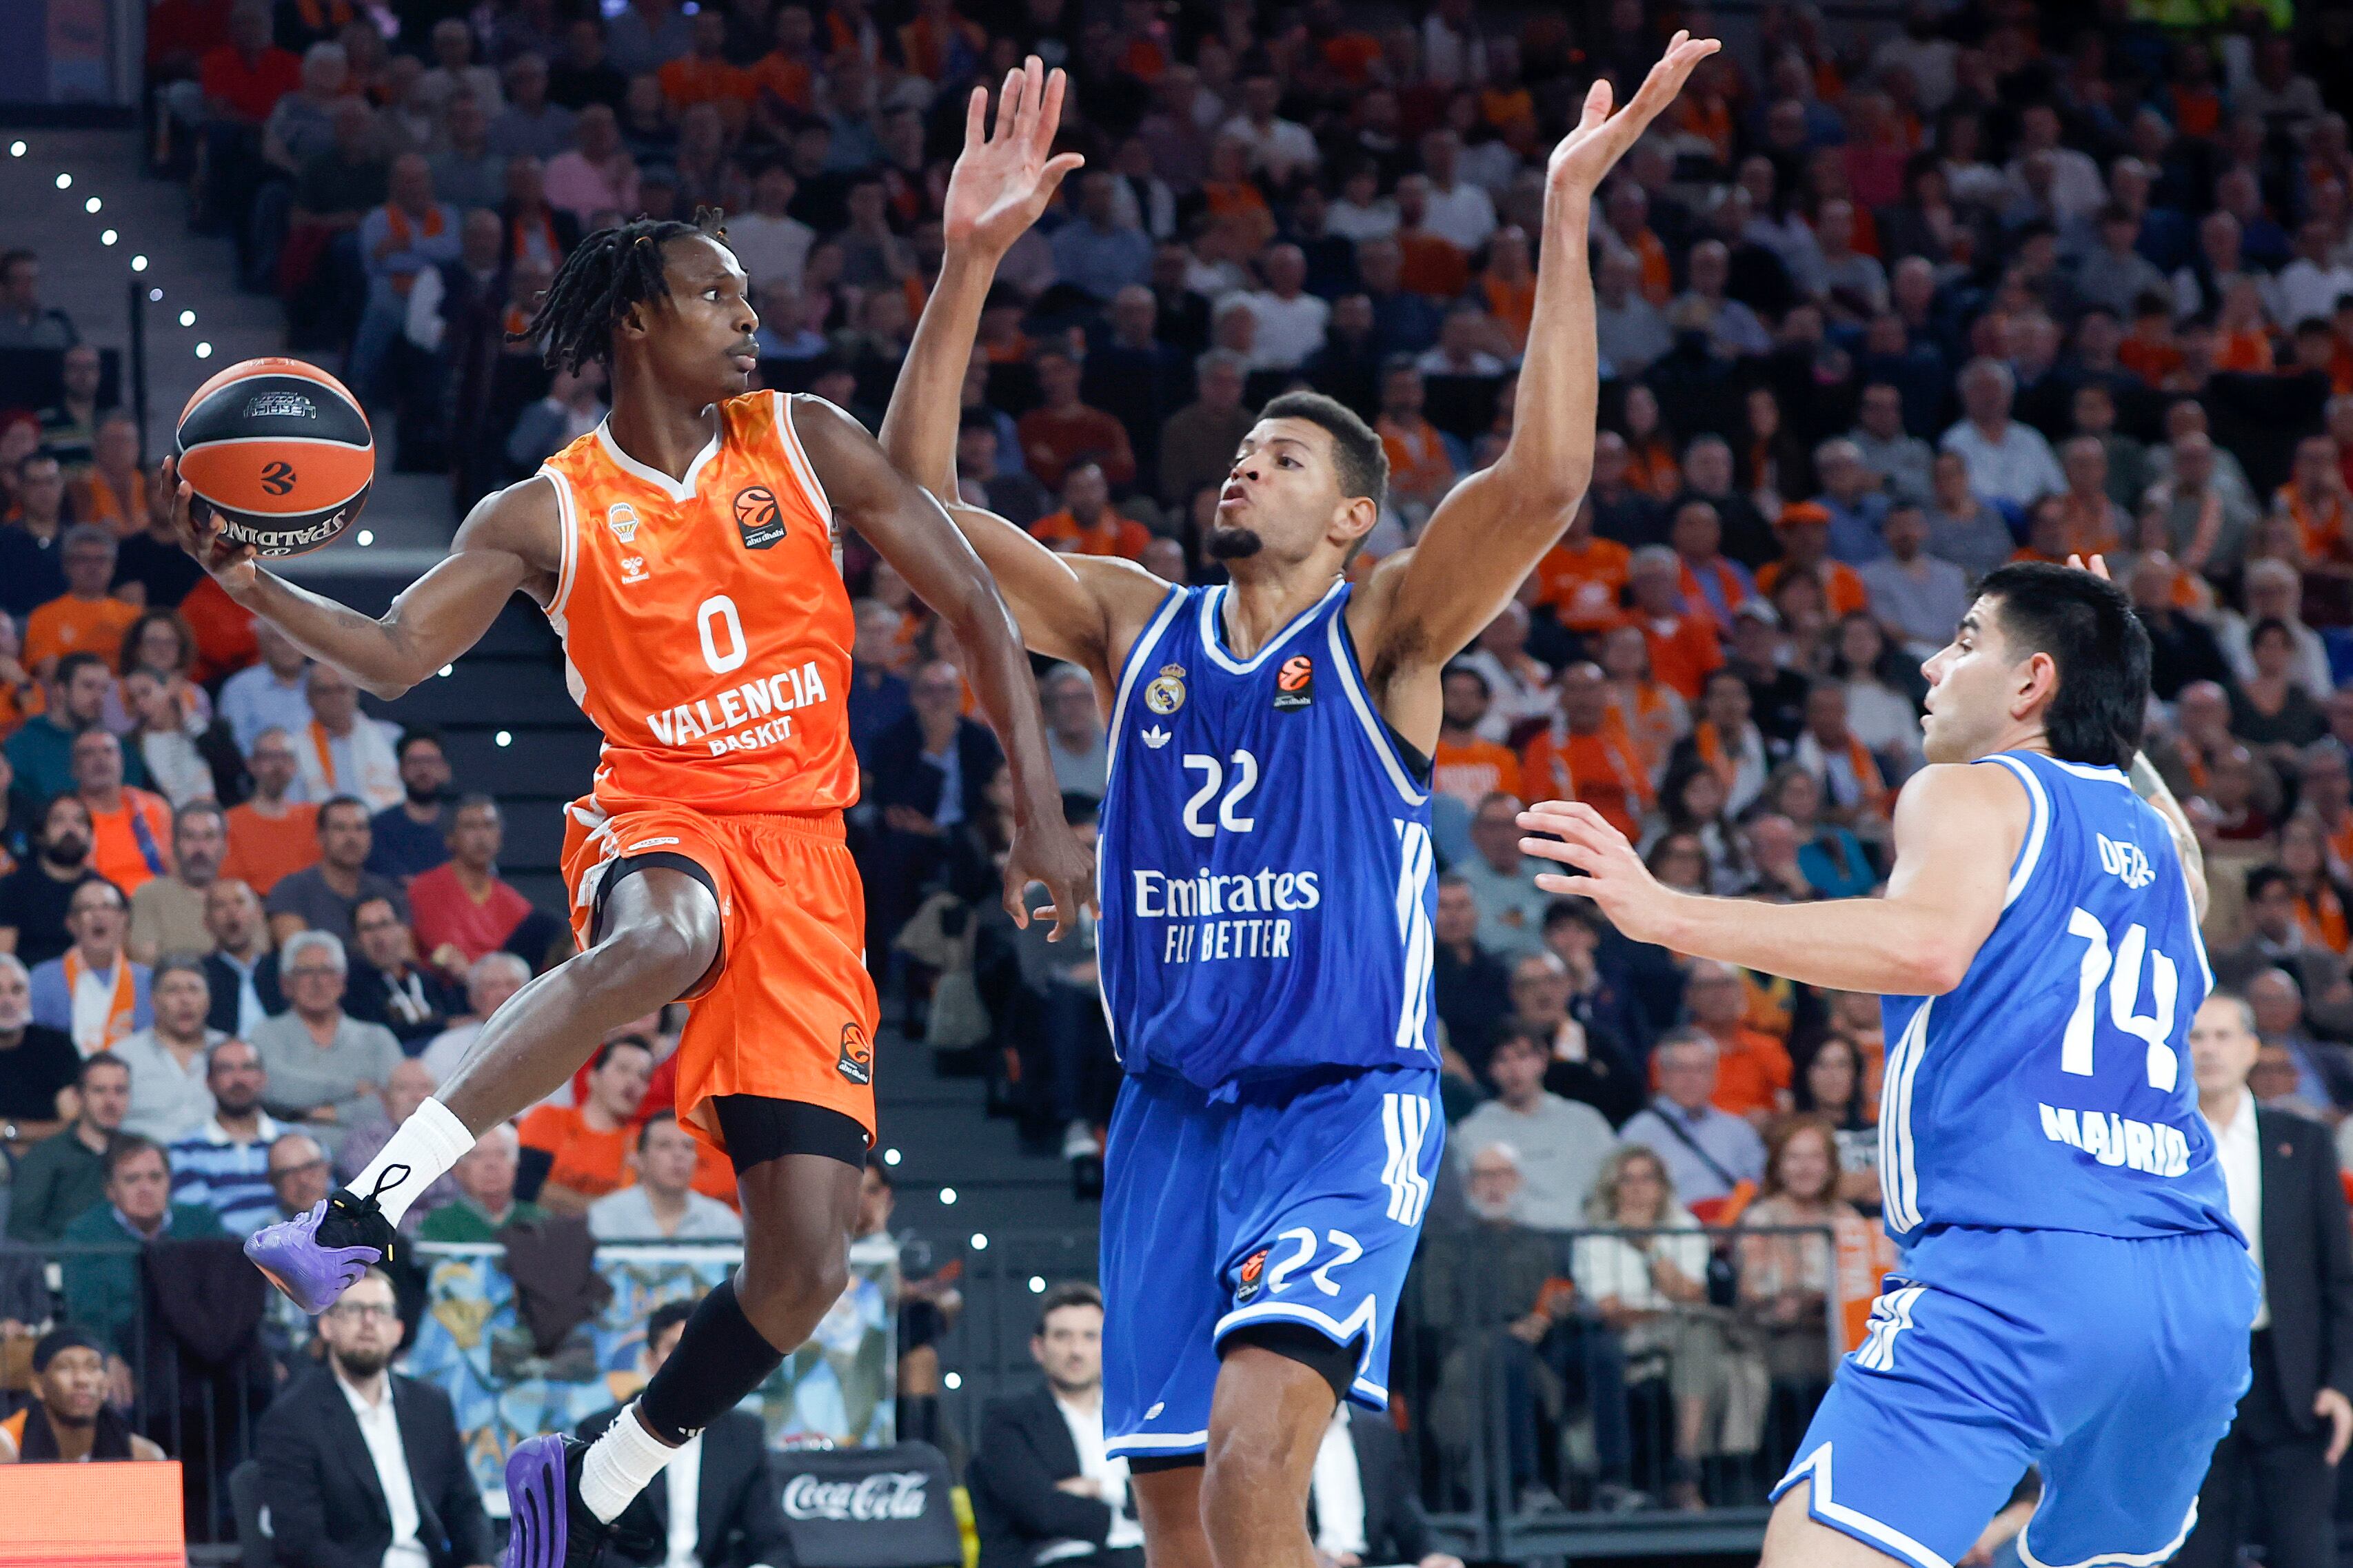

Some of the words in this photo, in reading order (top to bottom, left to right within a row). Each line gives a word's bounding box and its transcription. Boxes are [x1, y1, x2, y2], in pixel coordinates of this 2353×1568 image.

[697, 594, 748, 675] 0
[646, 661, 827, 747] VALENCIA
[707, 715, 792, 757] BASKET
[1183, 749, 1258, 837] 22
[1133, 866, 1320, 917] Emirates
[1201, 919, 1291, 962] BETTER
[2061, 906, 2179, 1093] 14
[1268, 1227, 1364, 1296] 22
